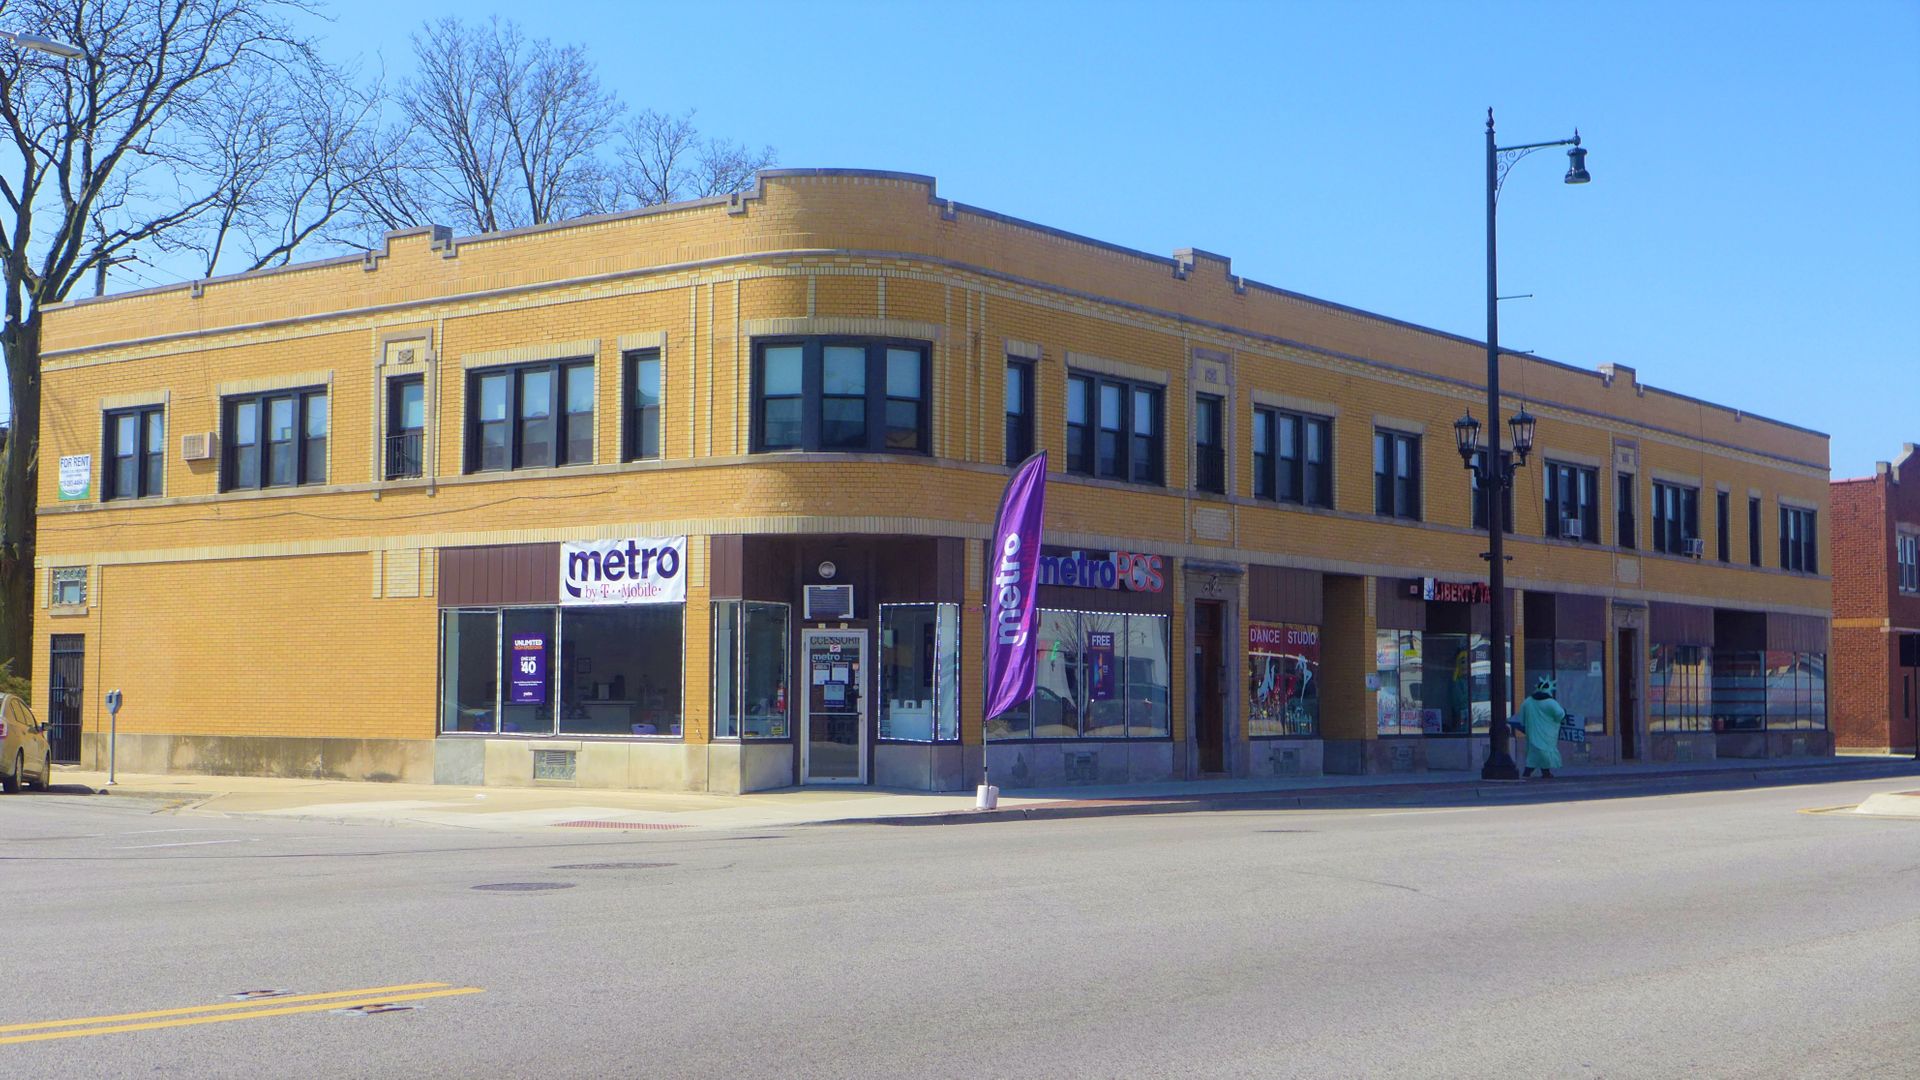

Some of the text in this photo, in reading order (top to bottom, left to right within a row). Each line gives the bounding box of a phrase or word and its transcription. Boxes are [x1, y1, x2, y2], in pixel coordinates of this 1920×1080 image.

[61, 455, 89, 467] FOR RENT
[568, 540, 680, 582] metro
[585, 584, 599, 599] by
[995, 532, 1022, 646] metro
[1435, 581, 1477, 604] LIBERTY
[1091, 635, 1111, 646] FREE
[1250, 628, 1317, 645] DANCE STUDIO
[812, 652, 841, 662] metro
